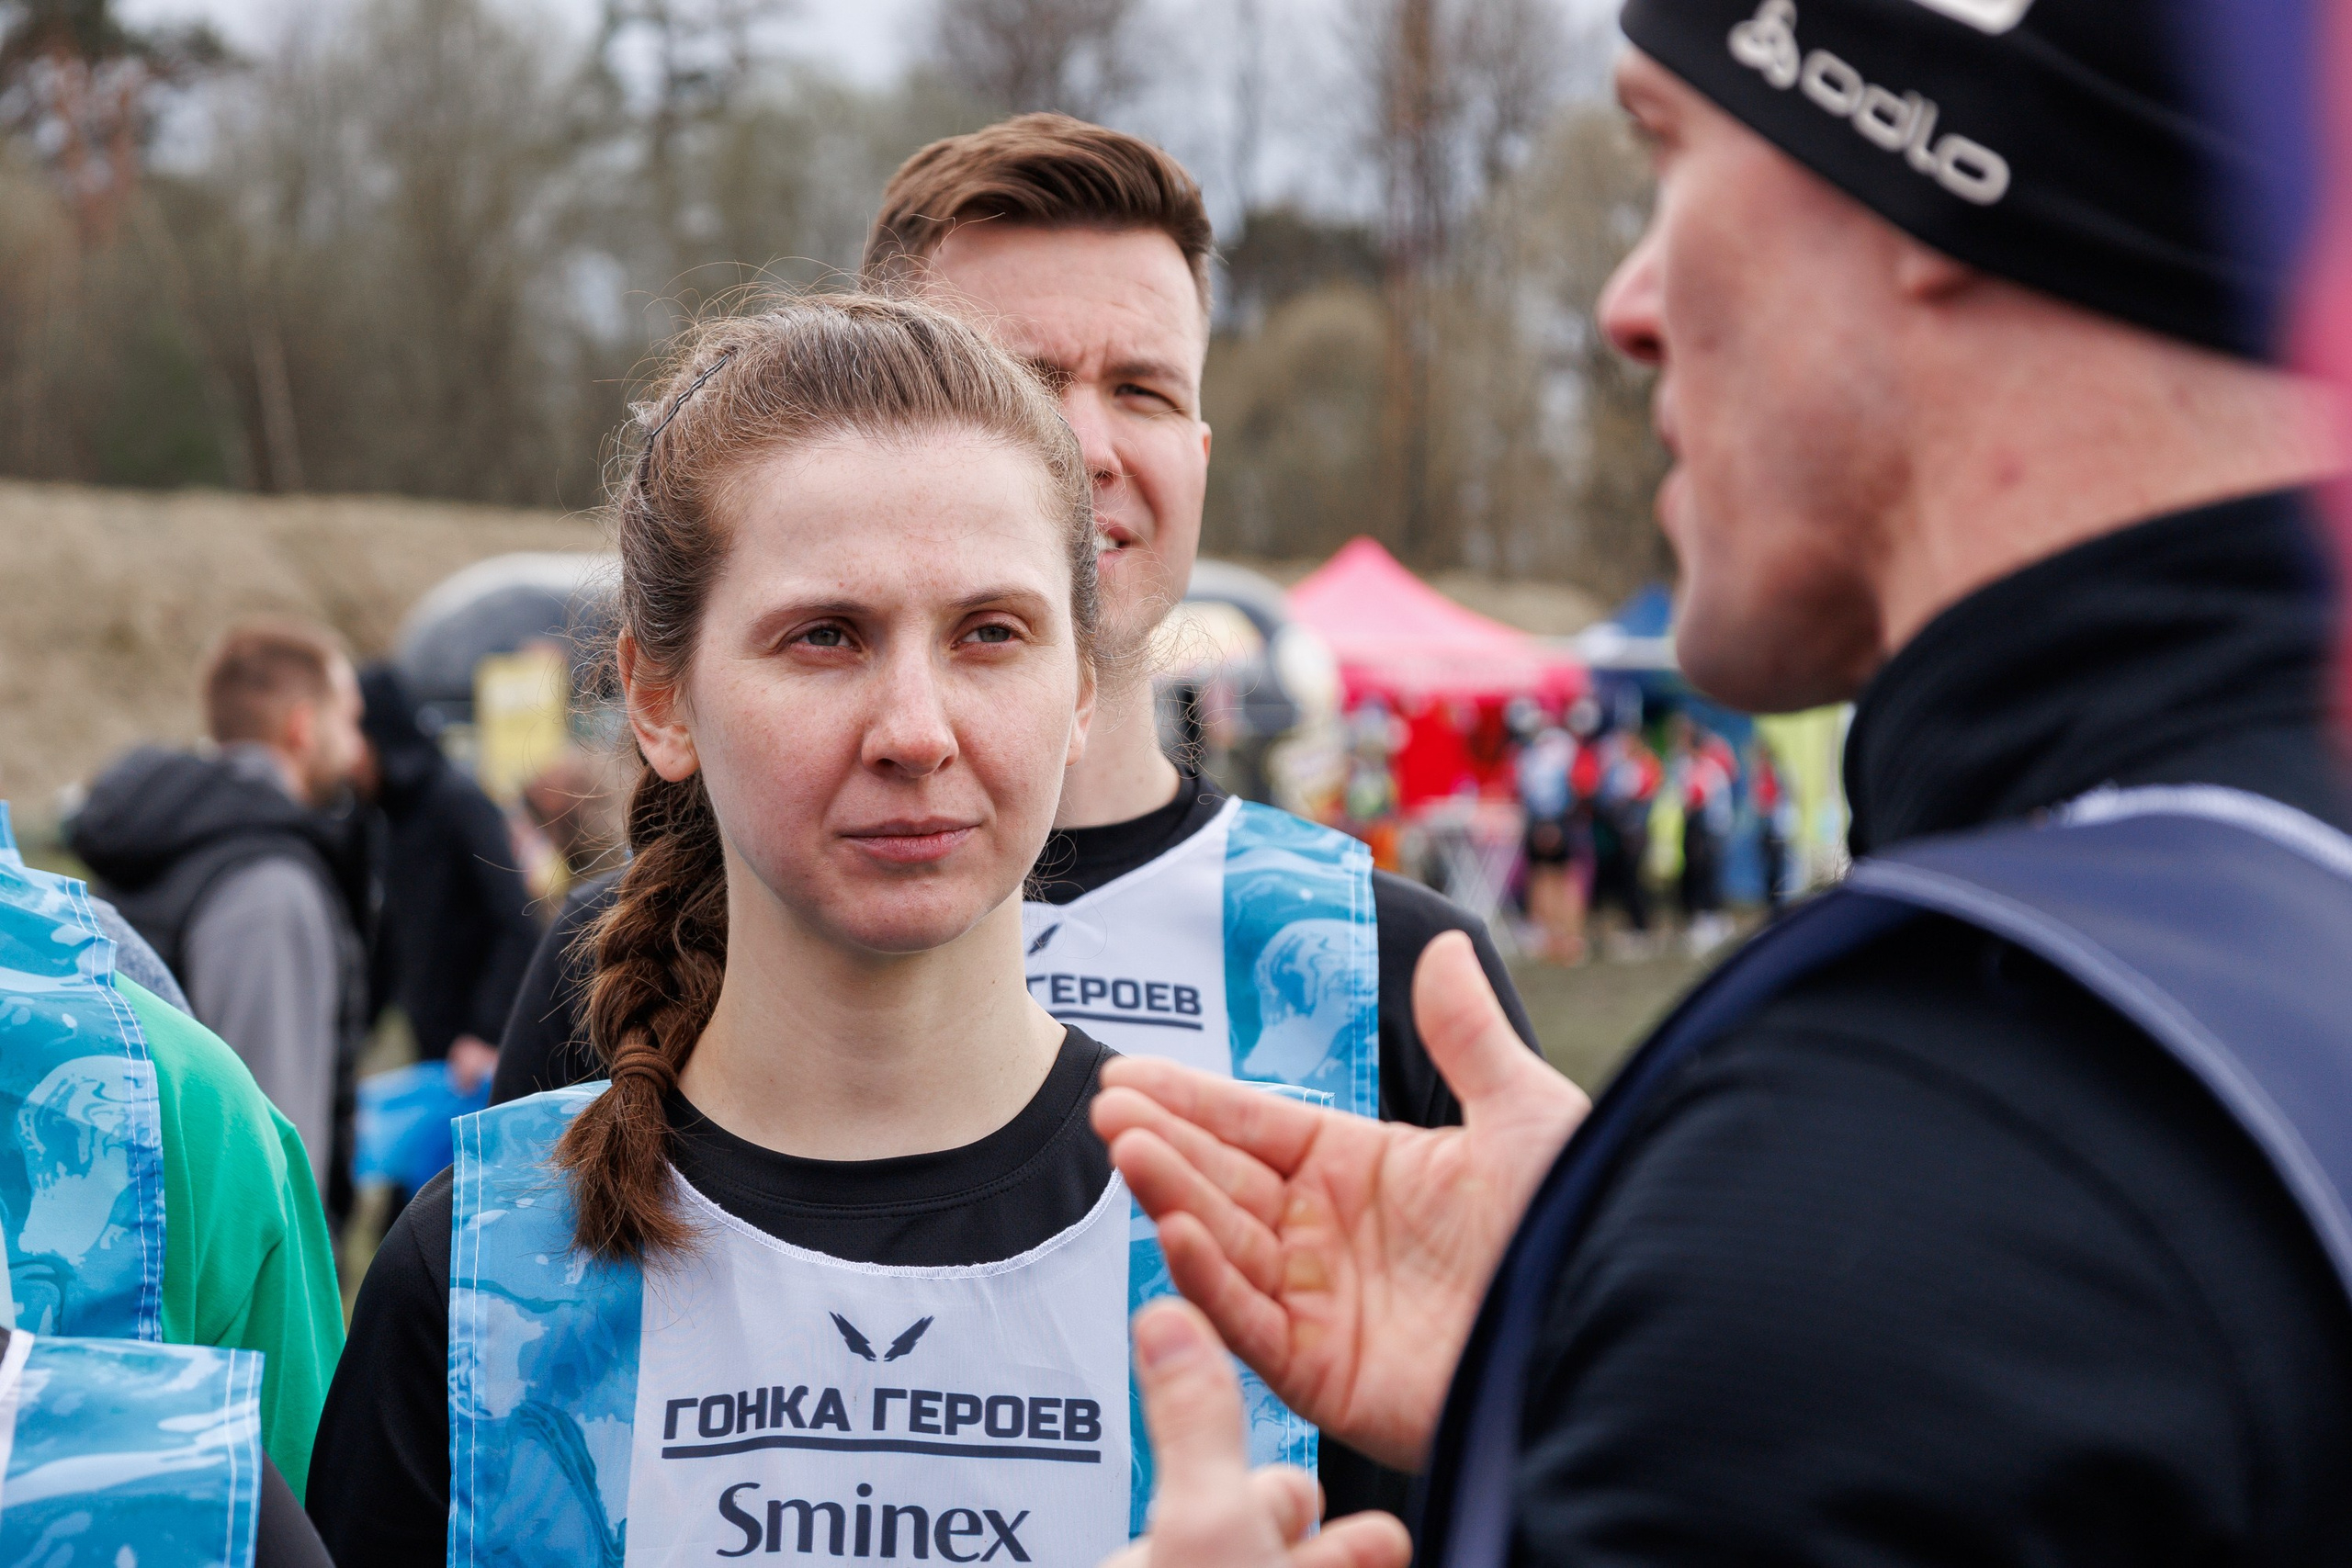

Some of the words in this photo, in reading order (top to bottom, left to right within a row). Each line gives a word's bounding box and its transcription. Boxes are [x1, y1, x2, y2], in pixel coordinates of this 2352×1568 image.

[1799, 48, 2011, 205] odlo
[663, 1385, 852, 1440] ГОНКА
[872, 1388, 1102, 1442] ГЕРОЕВ
[716, 1483, 1033, 1562] Sminex
